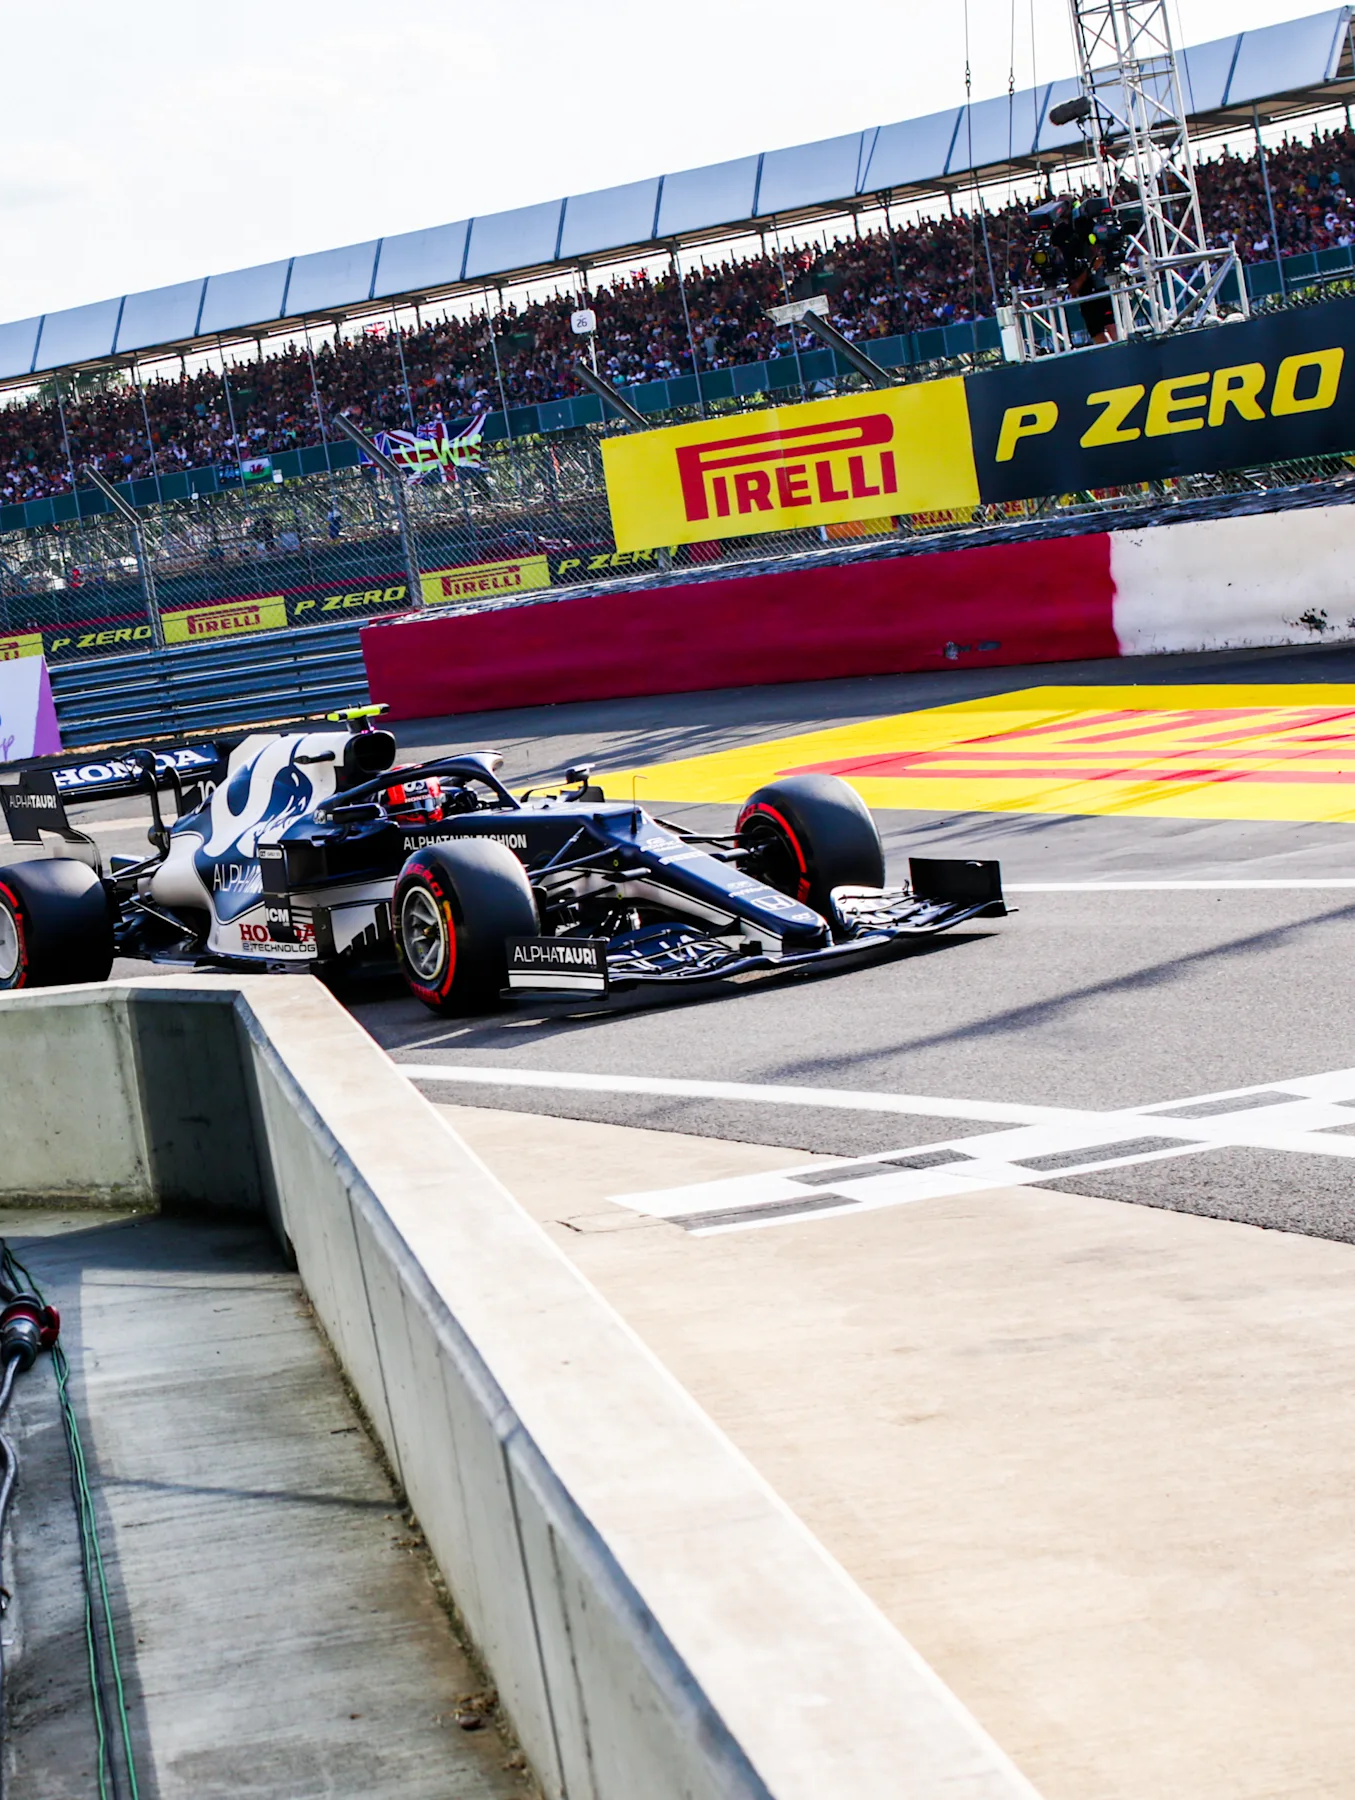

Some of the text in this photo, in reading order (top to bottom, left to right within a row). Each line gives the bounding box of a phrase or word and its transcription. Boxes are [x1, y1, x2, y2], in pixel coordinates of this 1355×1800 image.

[576, 318, 588, 328] 26
[995, 347, 1345, 463] P ZERO
[399, 434, 482, 472] LEWIS
[675, 413, 898, 522] PIRELLI
[441, 565, 522, 597] PIRELLI
[558, 559, 581, 575] P
[294, 586, 406, 616] P ZERO
[186, 605, 261, 635] PIRELLI
[51, 624, 152, 653] P ZERO
[10, 794, 56, 809] ALPHATAURI
[513, 945, 598, 967] ALPHATAURI
